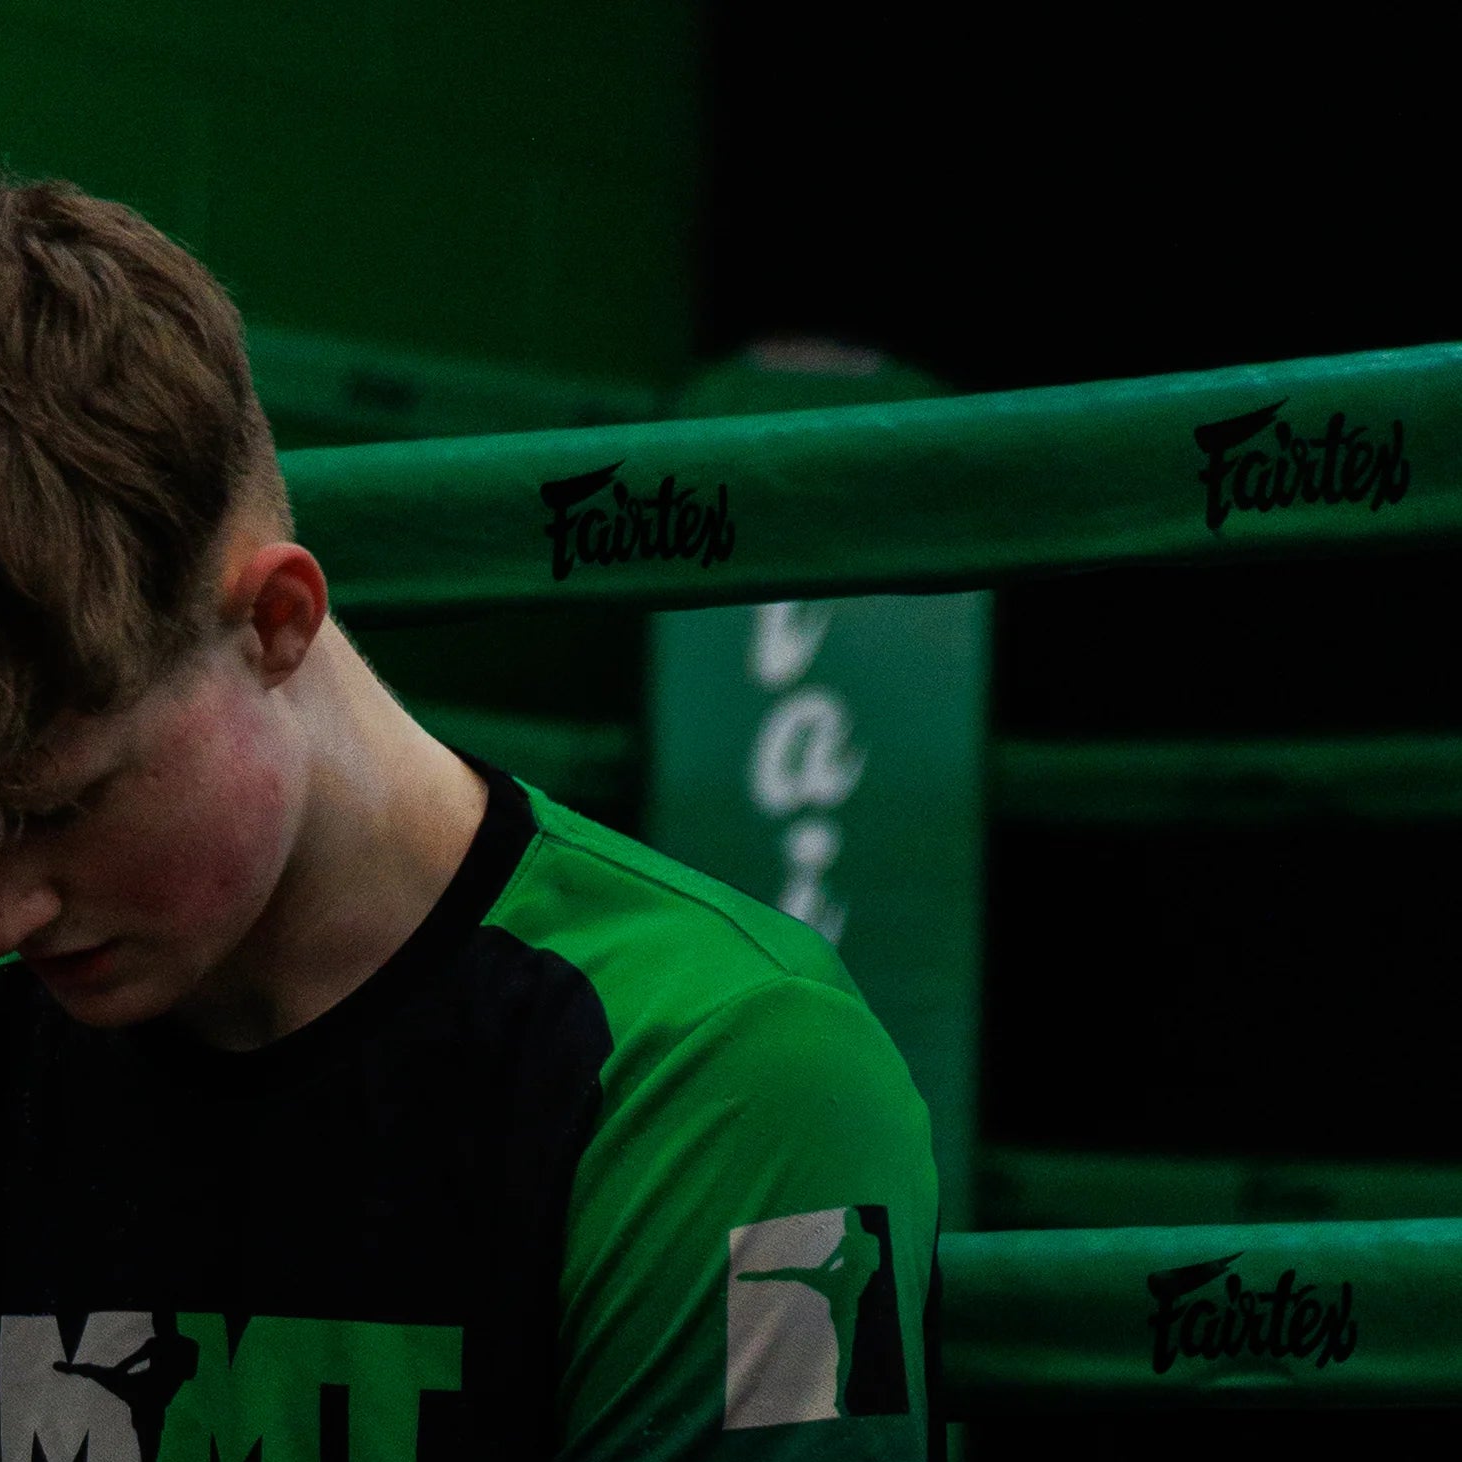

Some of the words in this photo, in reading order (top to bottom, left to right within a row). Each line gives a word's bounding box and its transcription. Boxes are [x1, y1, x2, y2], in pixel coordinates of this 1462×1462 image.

[540, 461, 737, 580] Fairtex
[1193, 398, 1410, 532] Fairtex
[1147, 1250, 1358, 1375] Fairtex
